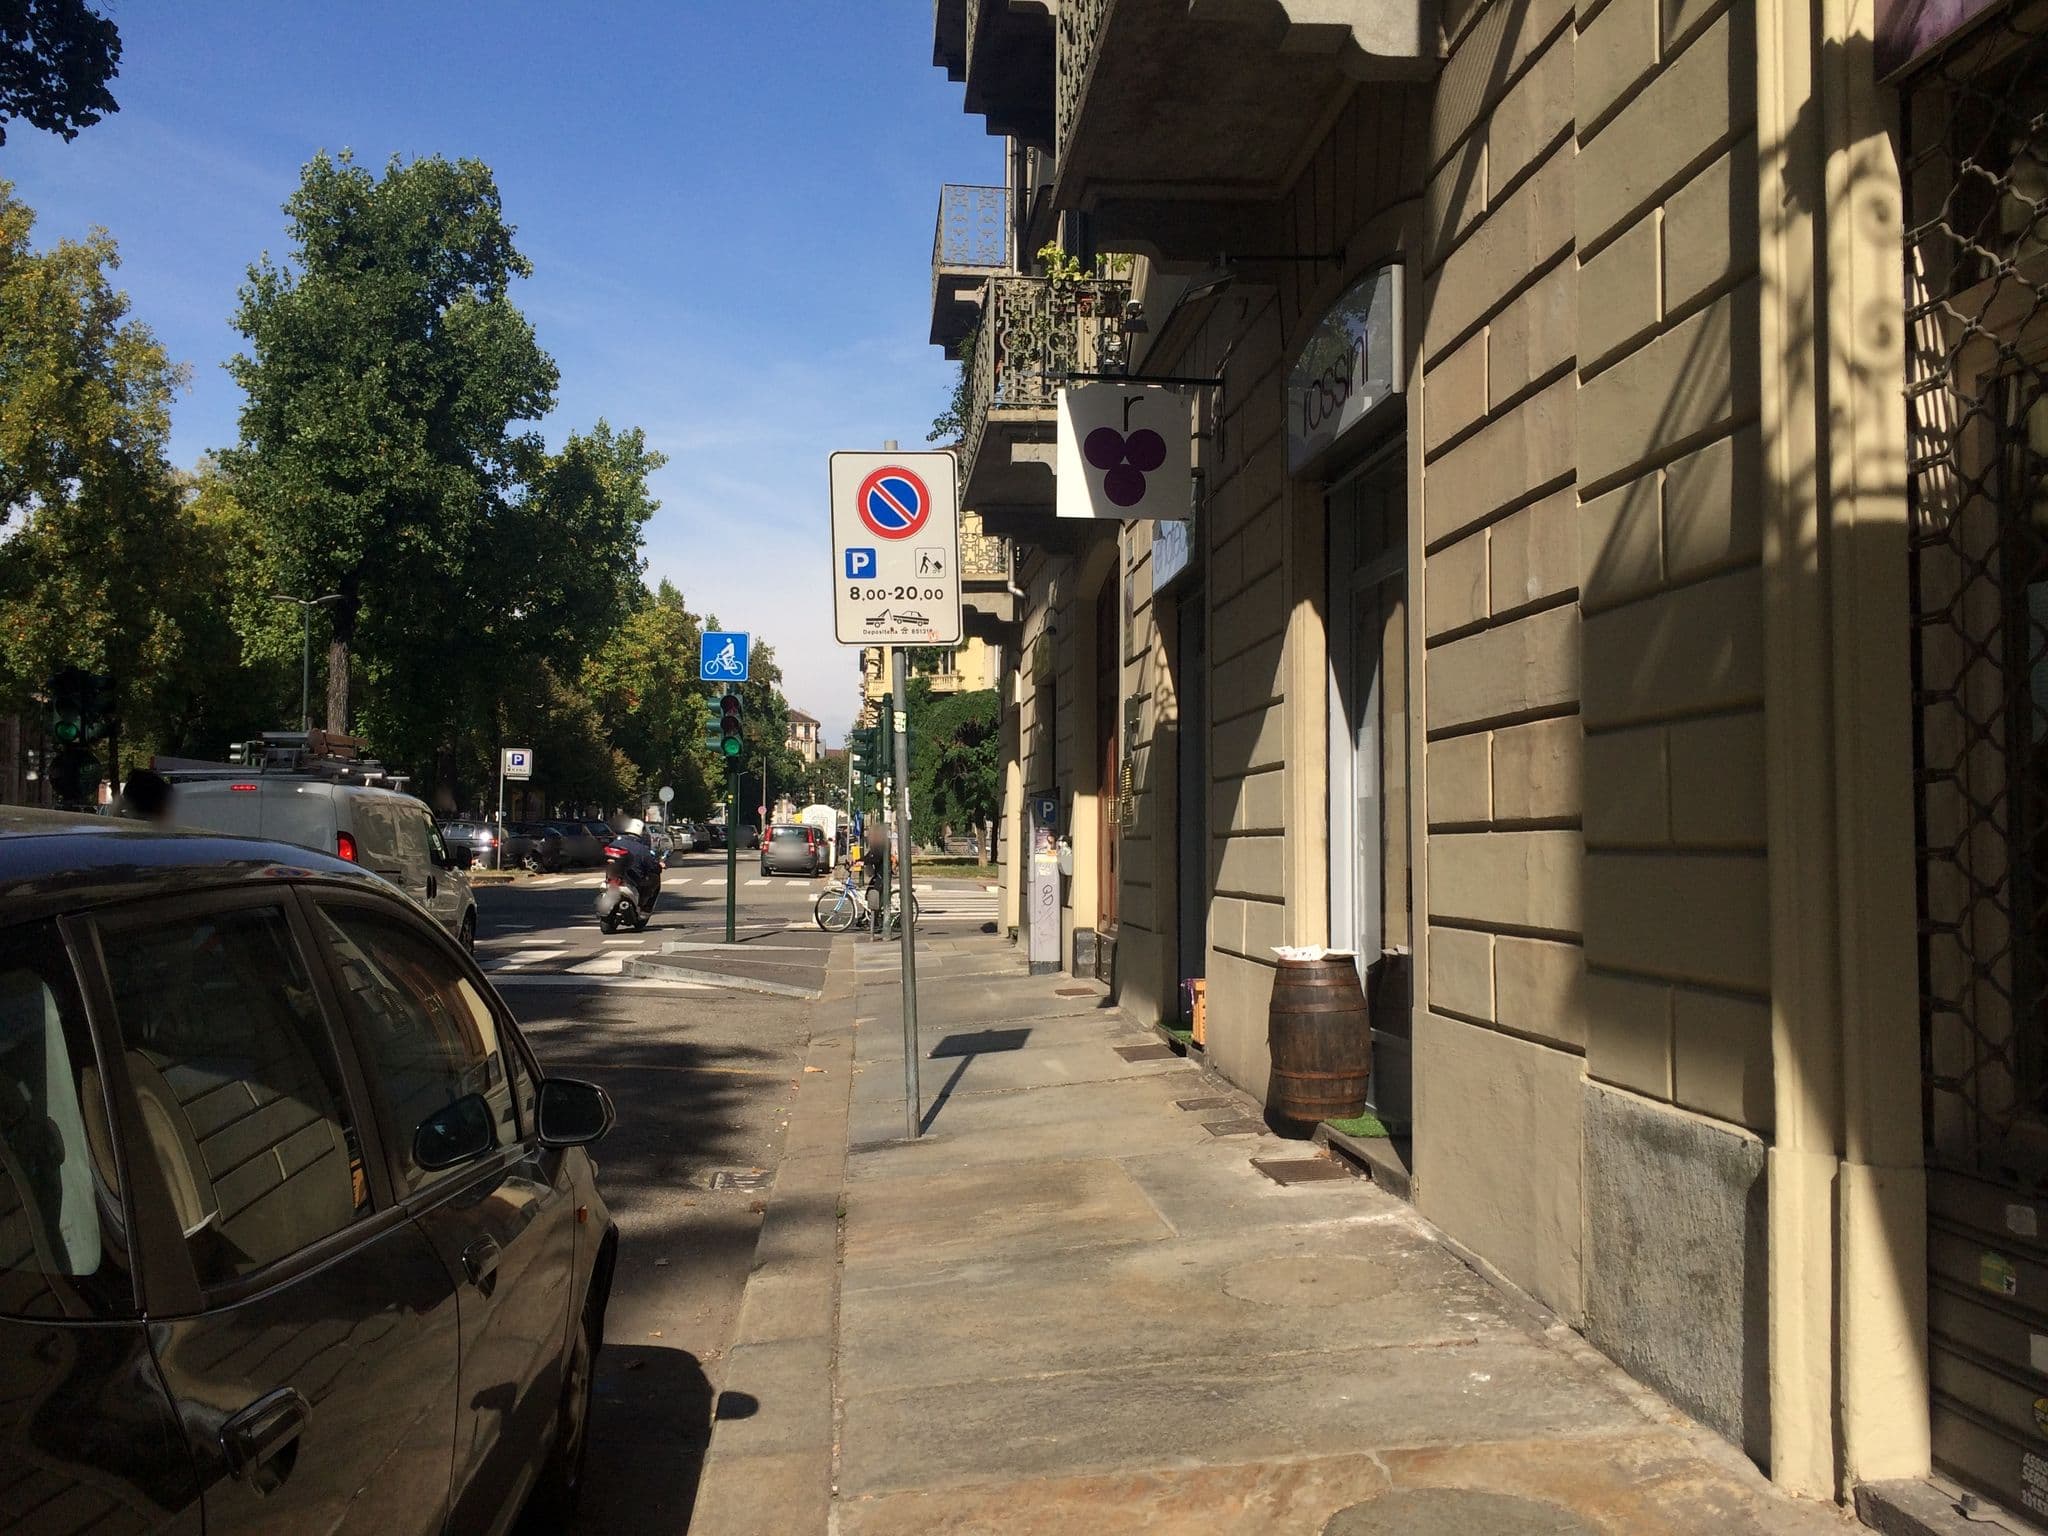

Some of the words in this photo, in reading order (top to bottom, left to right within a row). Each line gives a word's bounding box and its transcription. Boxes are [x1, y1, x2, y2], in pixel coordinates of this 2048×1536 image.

[1123, 396, 1144, 432] r
[852, 552, 870, 575] P
[850, 586, 944, 602] 8.00-20.00
[514, 755, 523, 765] P
[1043, 801, 1054, 818] P
